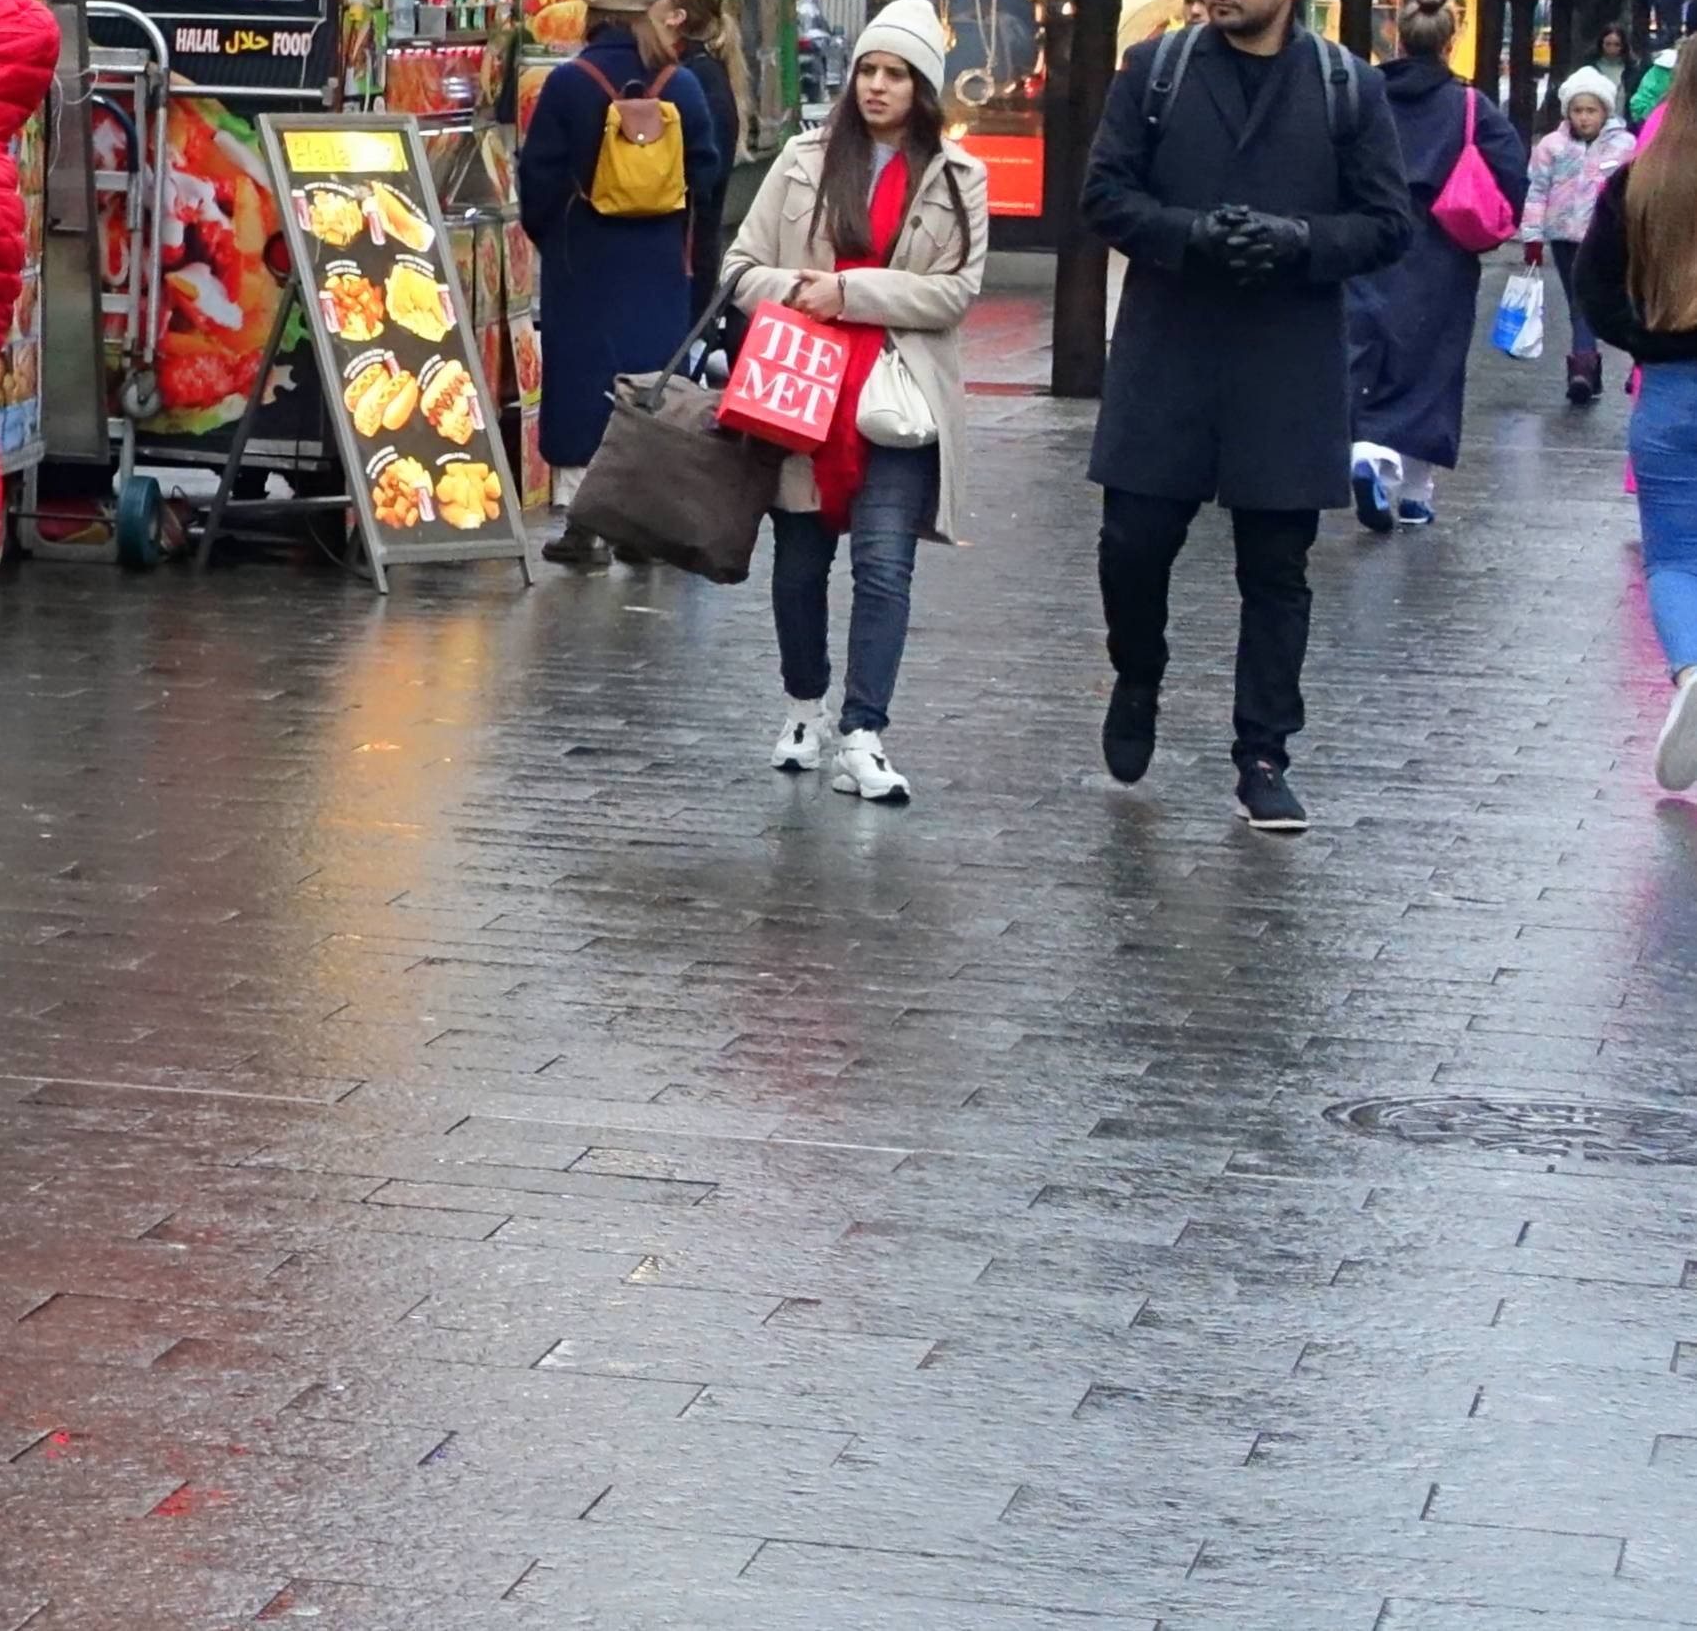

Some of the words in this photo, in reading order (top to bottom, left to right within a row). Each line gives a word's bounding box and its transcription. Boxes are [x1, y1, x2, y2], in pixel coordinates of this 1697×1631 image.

[175, 28, 221, 53] HALAL
[225, 30, 270, 54] حلال
[271, 31, 313, 57] FOOD
[756, 315, 843, 383] THE
[736, 357, 836, 426] MET
